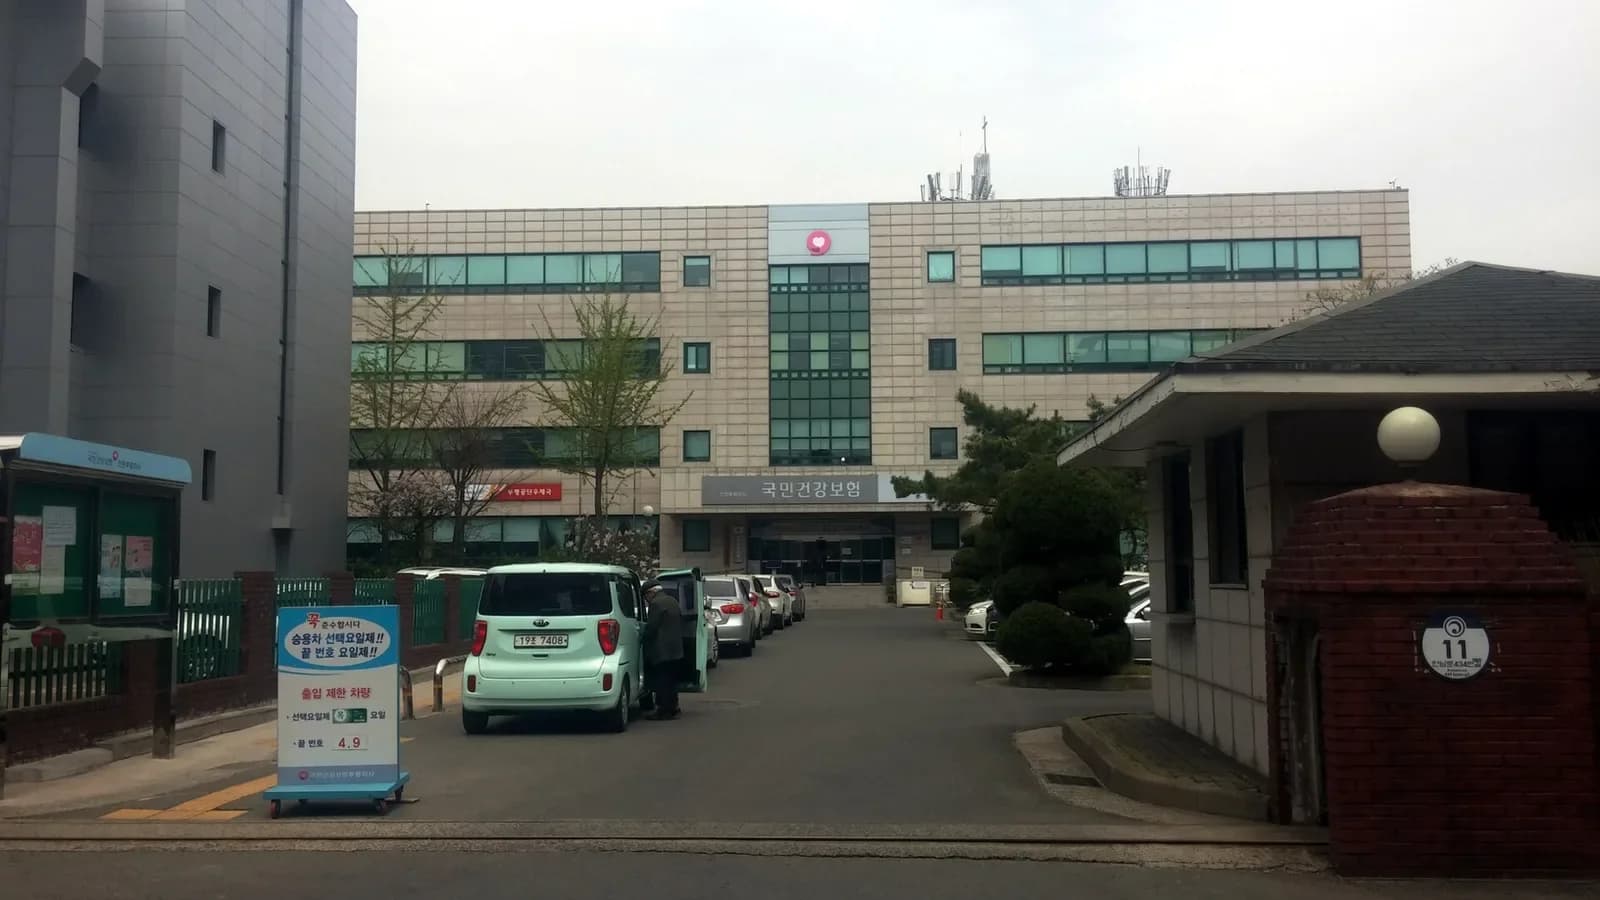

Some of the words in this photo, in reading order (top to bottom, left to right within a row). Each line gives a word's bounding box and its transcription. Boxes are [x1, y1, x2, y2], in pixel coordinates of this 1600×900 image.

[762, 481, 861, 498] 국민건강보험
[306, 612, 321, 629] 꼭
[291, 633, 322, 646] 승용차
[325, 632, 384, 645] 선택요일제!!
[540, 636, 564, 645] 7408
[301, 647, 311, 659] 끝
[315, 647, 335, 659] 번호
[338, 646, 378, 659] 요일제!!
[1442, 639, 1467, 659] 11
[302, 687, 322, 700] 출입
[326, 687, 346, 699] 제한
[350, 687, 371, 699] 차량
[292, 711, 330, 721] 선택요일제
[370, 710, 386, 720] 요일
[308, 738, 324, 748] 번호
[338, 737, 361, 749] 4.9
